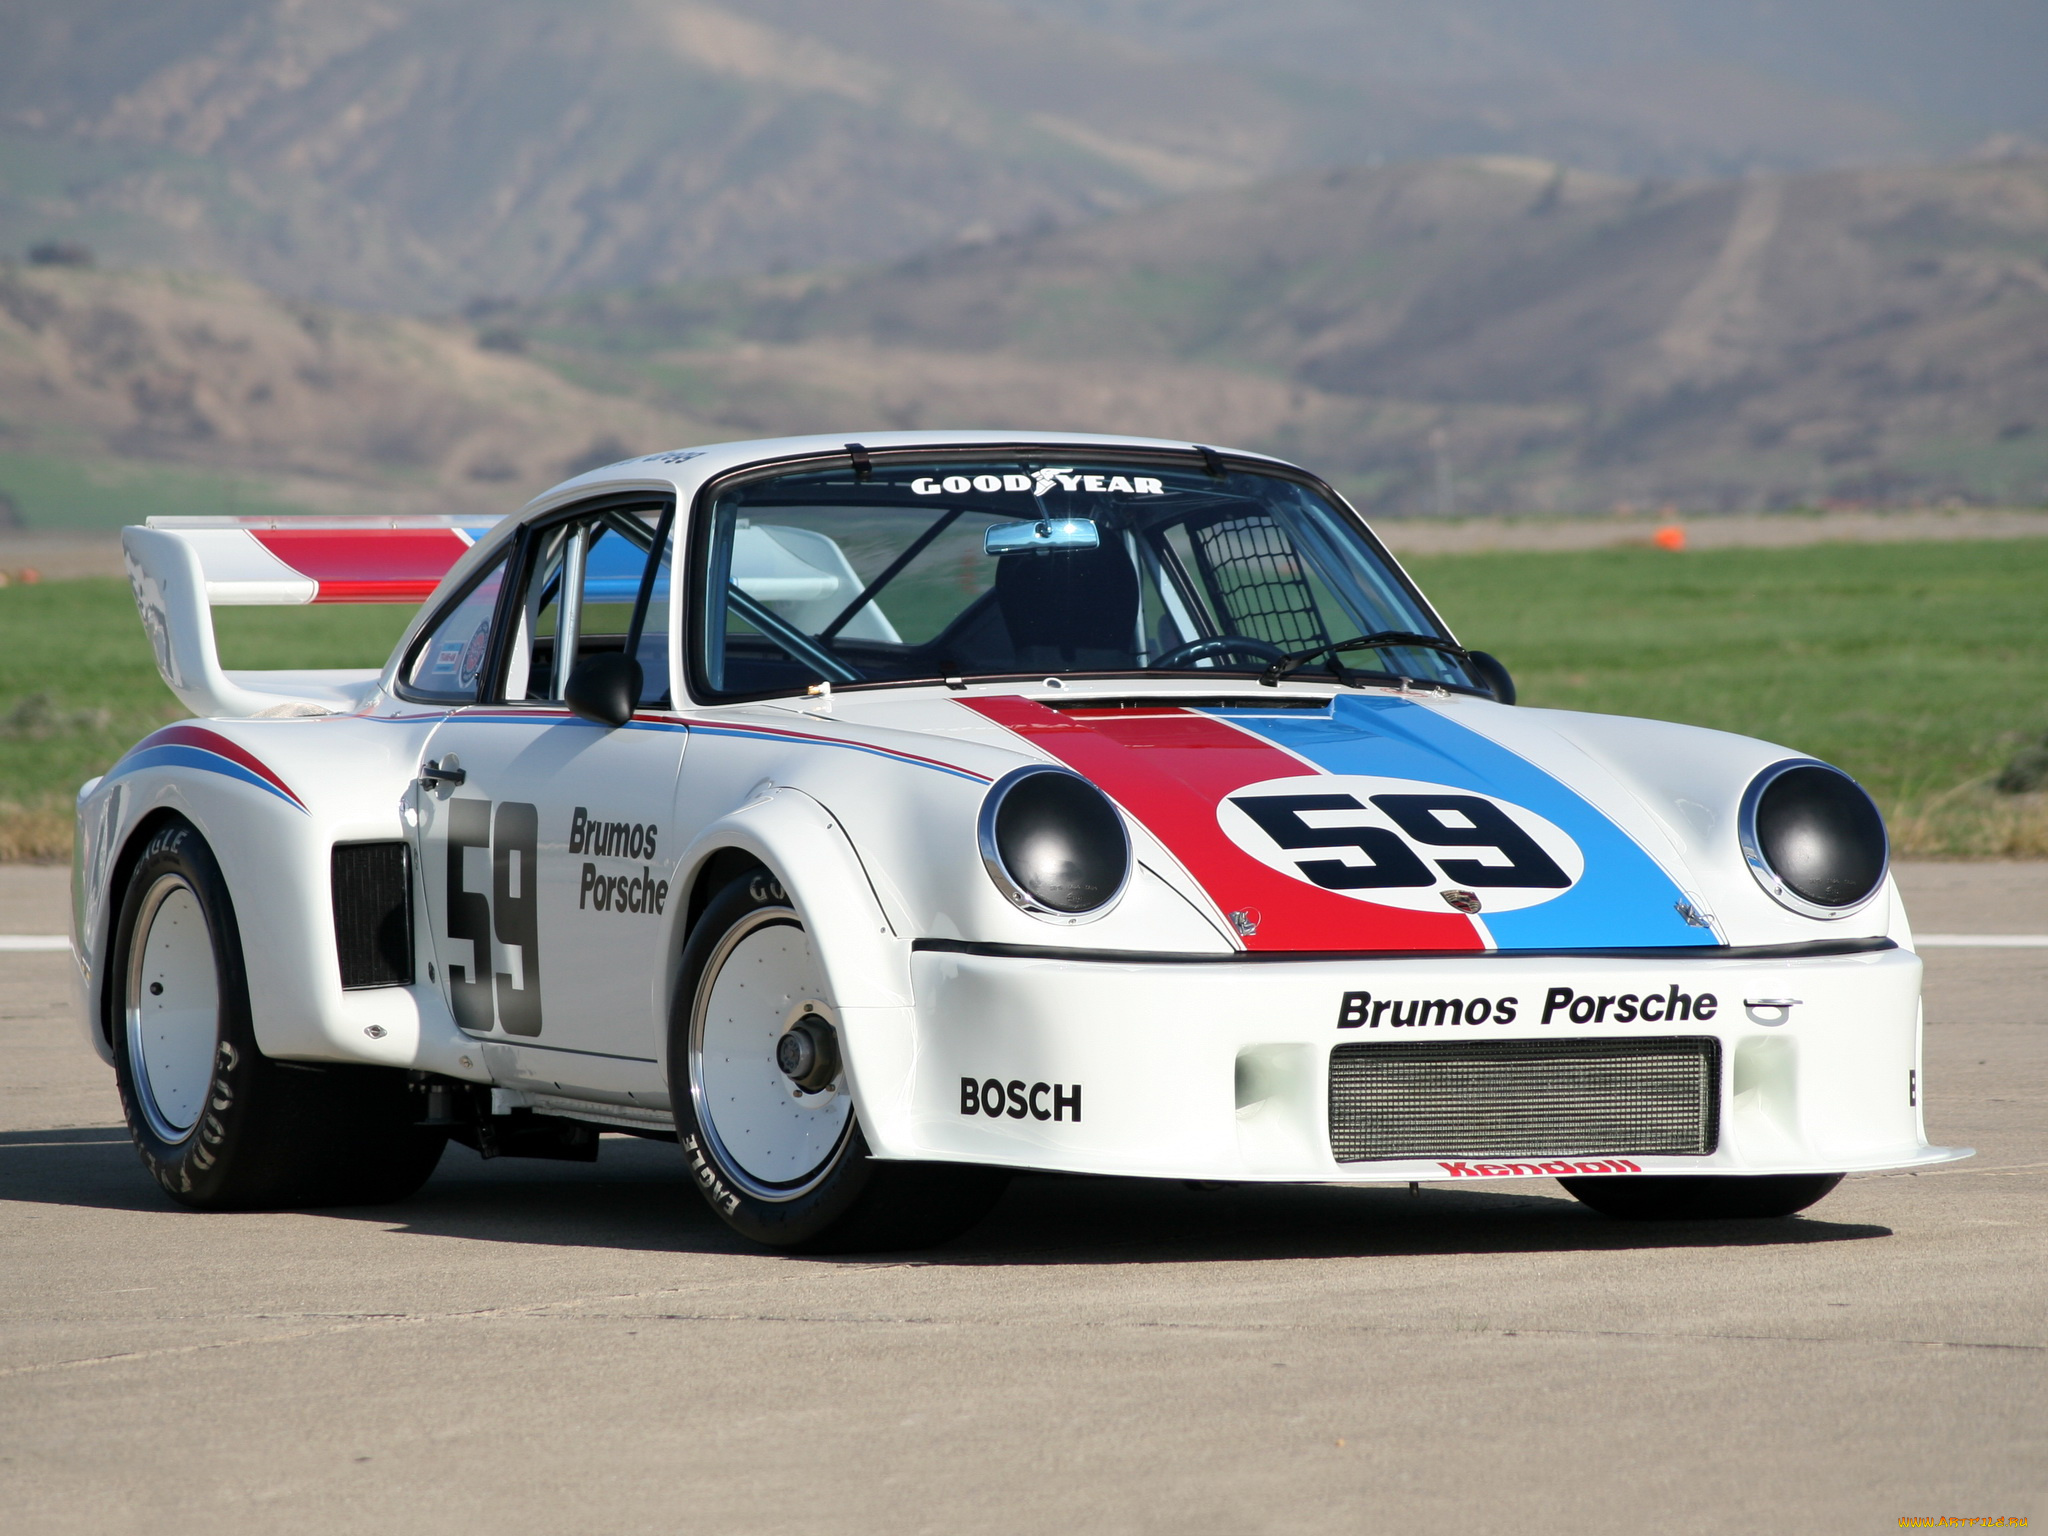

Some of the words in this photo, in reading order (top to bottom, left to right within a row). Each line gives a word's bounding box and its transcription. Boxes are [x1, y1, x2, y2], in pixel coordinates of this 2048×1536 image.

[568, 806, 659, 861] Brumos
[1226, 793, 1573, 890] 59
[579, 862, 669, 916] Porsche
[446, 797, 543, 1038] 59
[1337, 991, 1518, 1029] Brumos
[1541, 984, 1718, 1025] Porsche
[960, 1076, 1082, 1122] BOSCH
[681, 1132, 742, 1217] EAGLE
[1436, 1158, 1643, 1178] Kendall
